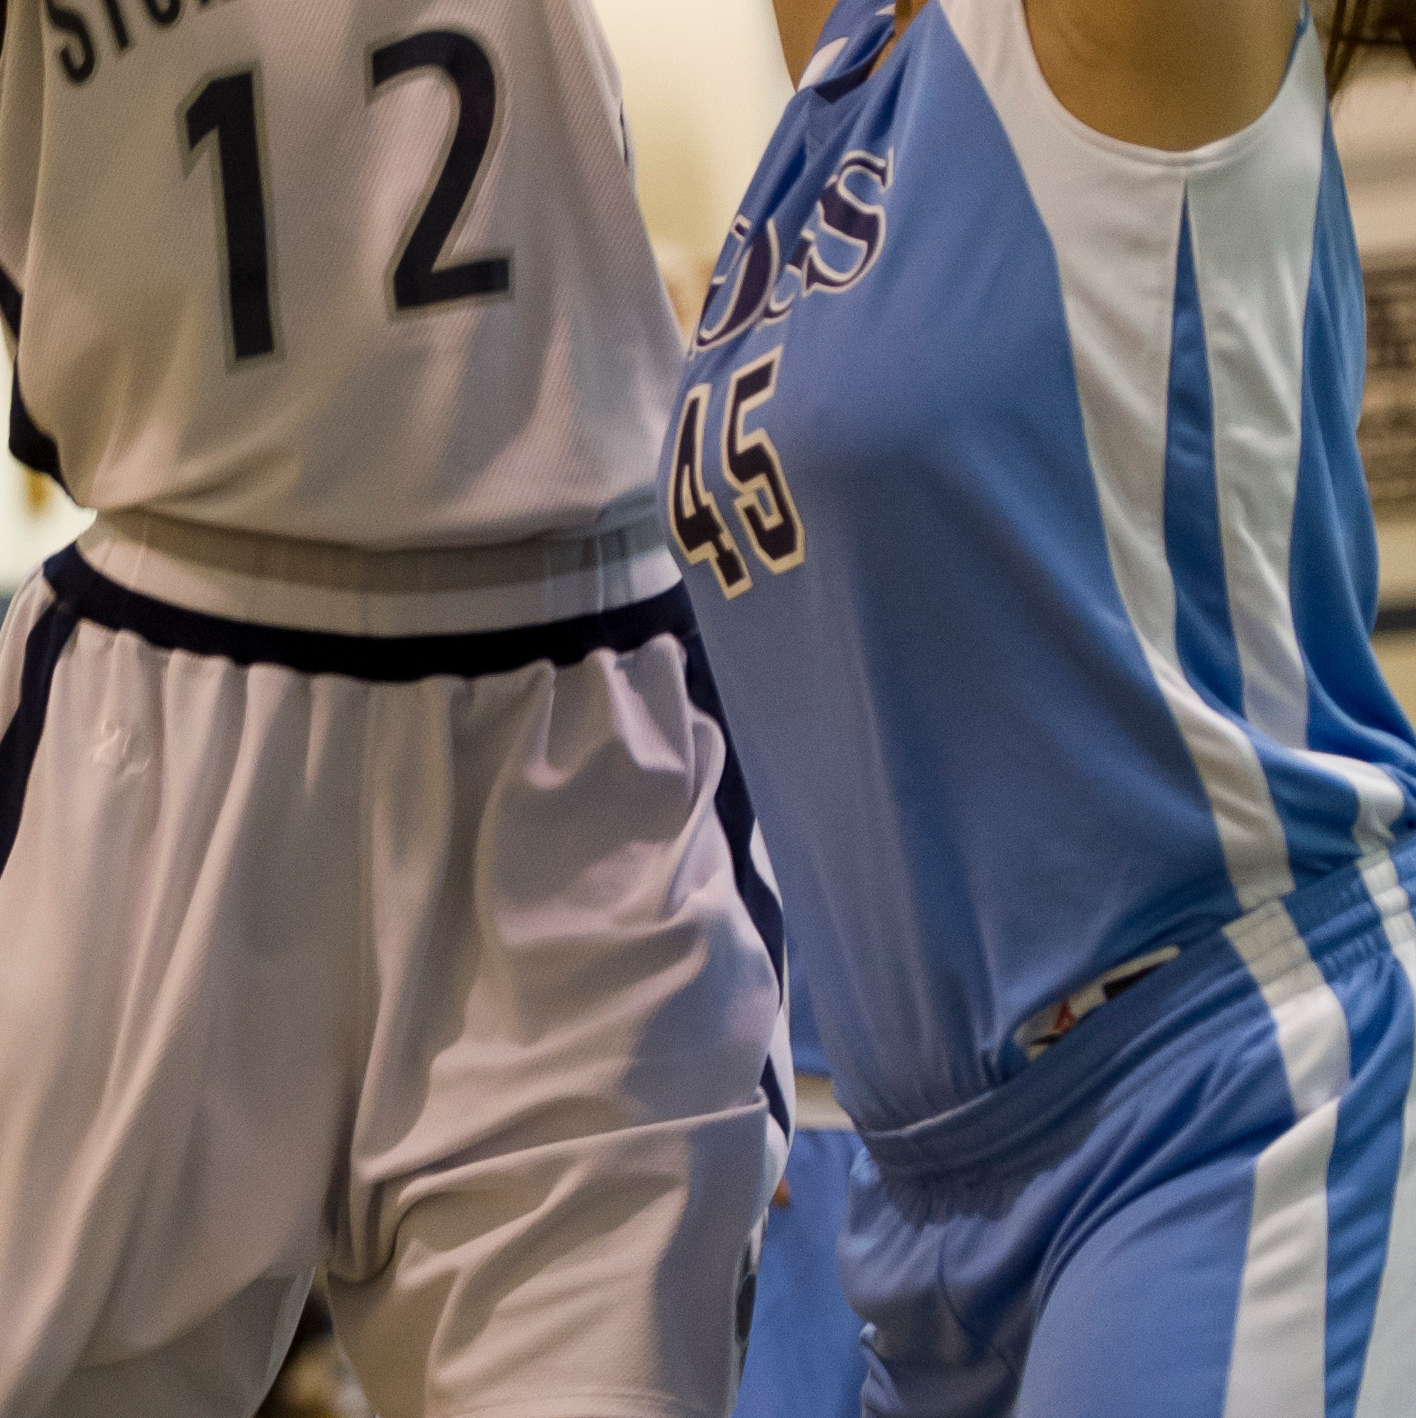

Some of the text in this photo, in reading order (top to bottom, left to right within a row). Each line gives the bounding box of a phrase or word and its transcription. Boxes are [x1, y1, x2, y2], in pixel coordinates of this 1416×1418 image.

[177, 27, 515, 373] 12
[688, 148, 896, 361] OS
[668, 345, 806, 601] 45
